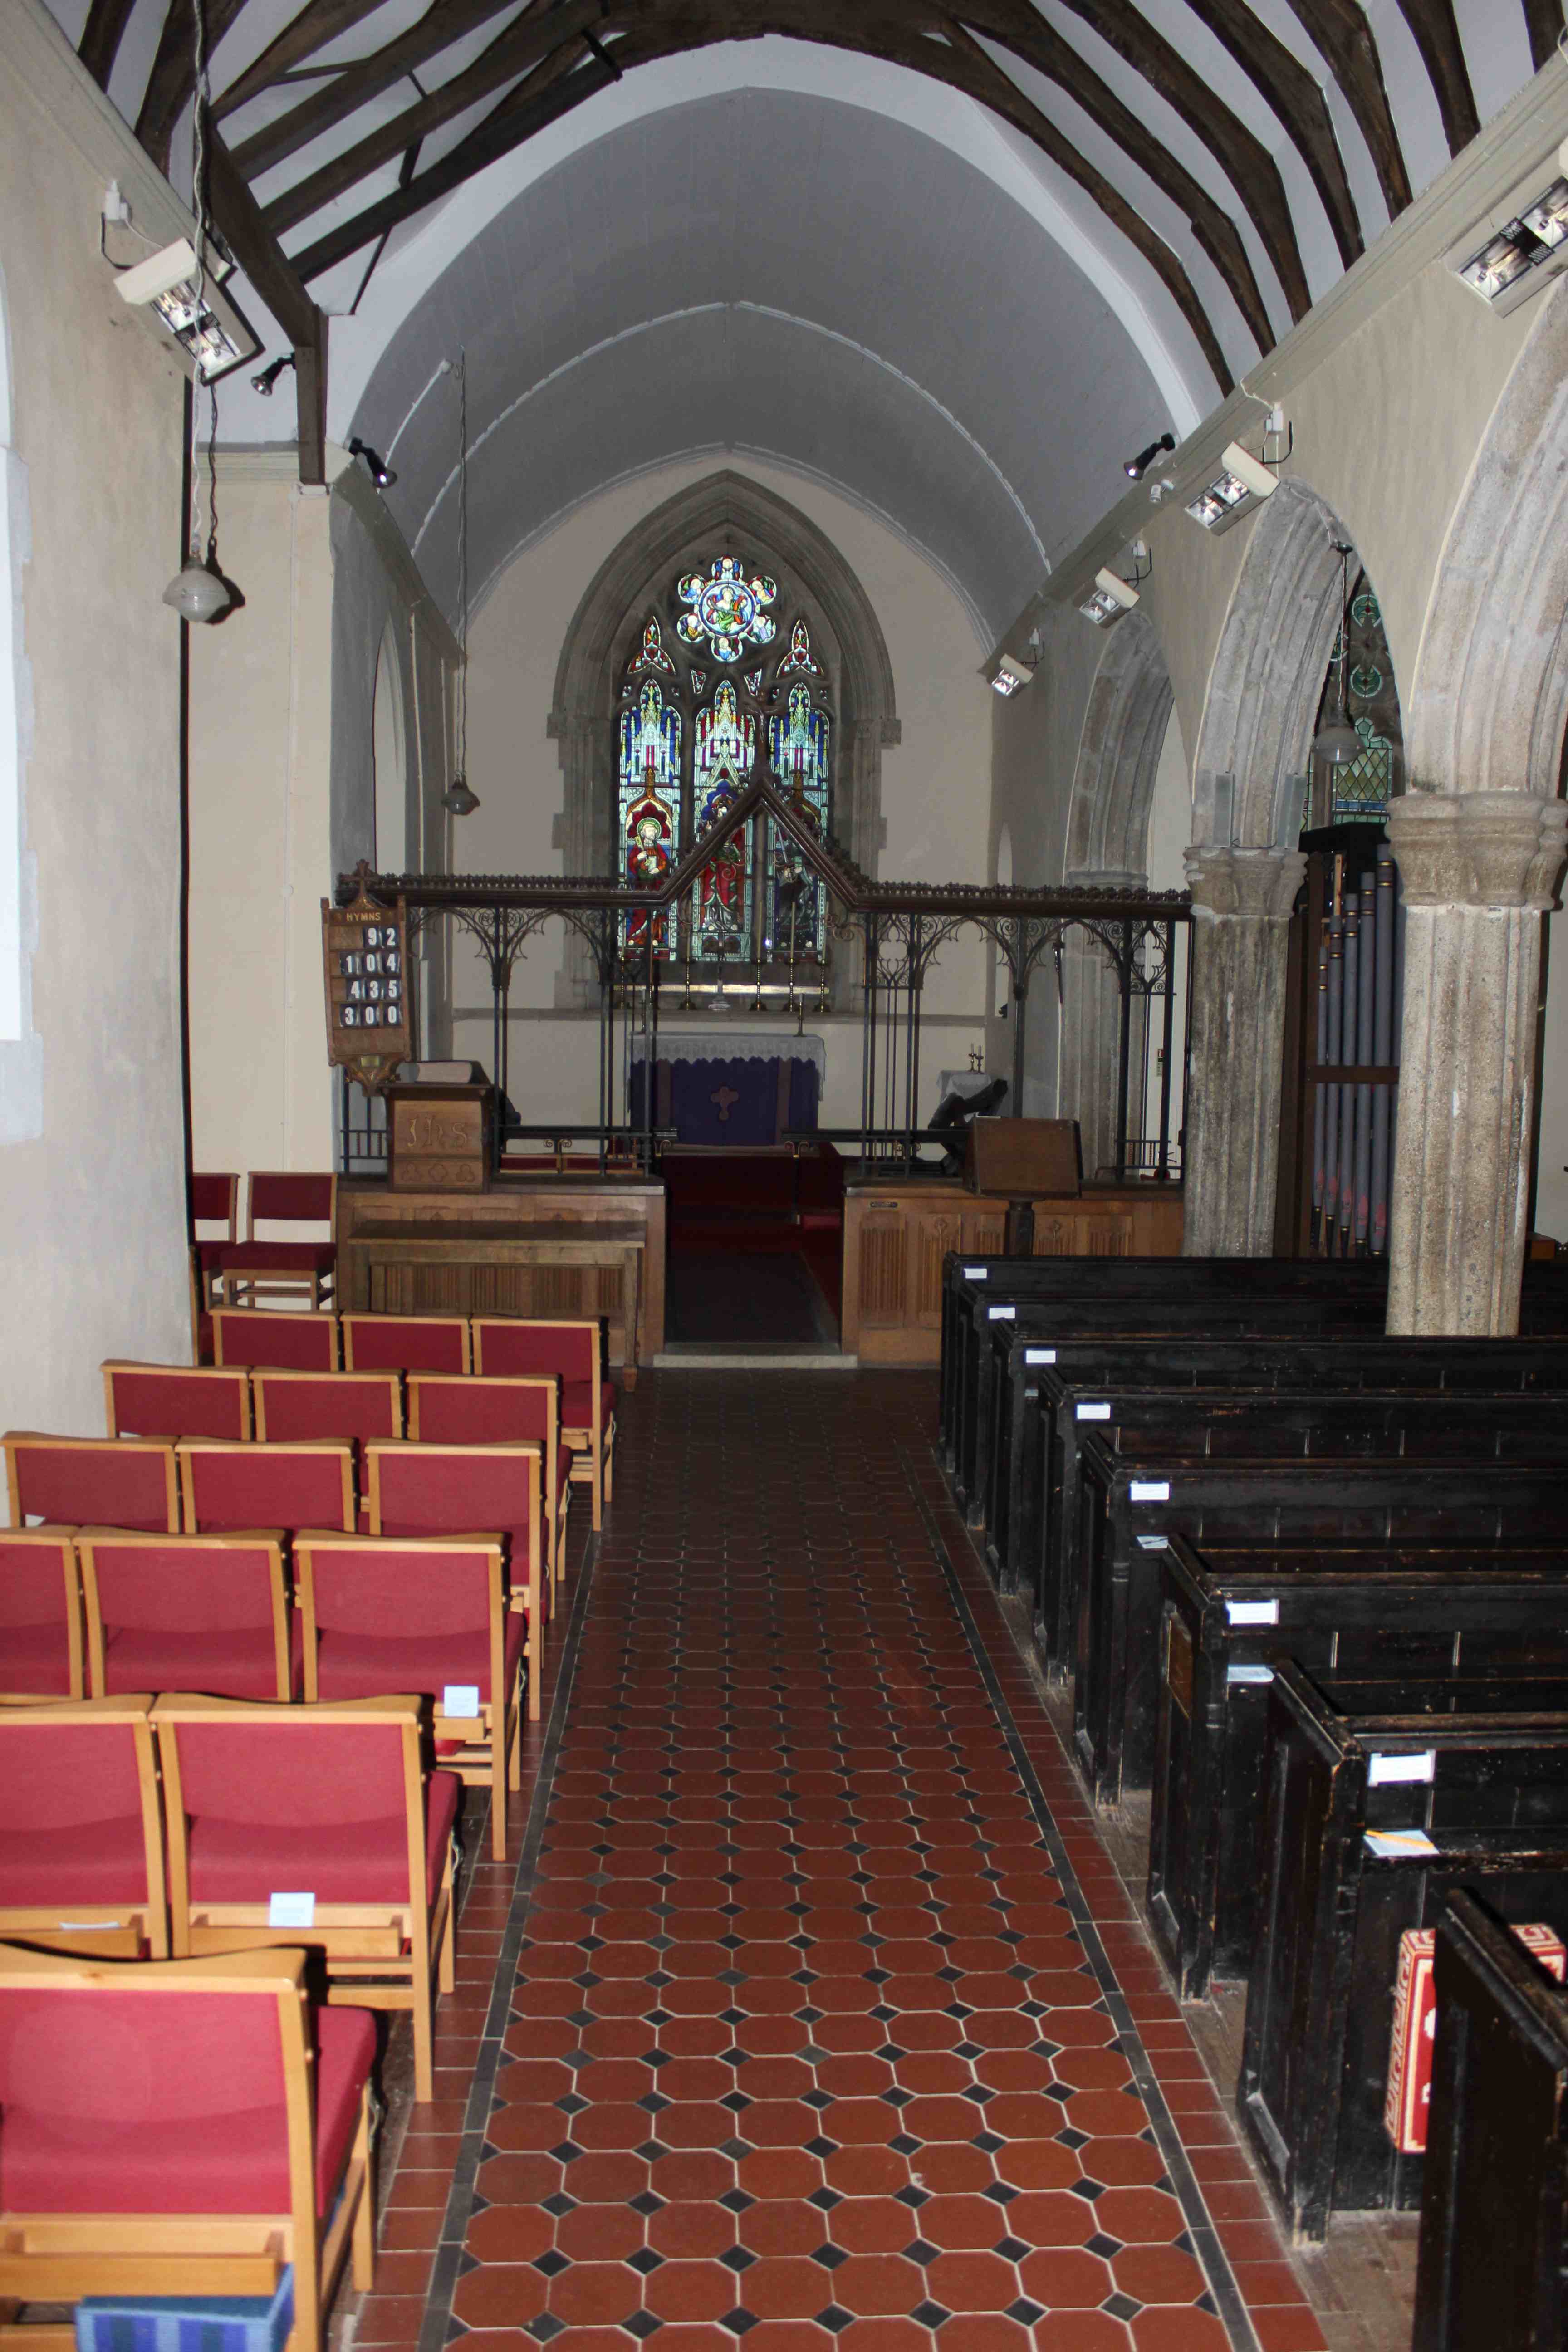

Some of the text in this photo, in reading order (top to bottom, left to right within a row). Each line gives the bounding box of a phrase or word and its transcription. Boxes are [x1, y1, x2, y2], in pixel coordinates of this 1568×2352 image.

[346, 911, 381, 921] HYMNS
[368, 927, 396, 946] 92
[346, 953, 396, 973] 104
[351, 980, 397, 999] 435
[344, 1006, 397, 1024] 300
